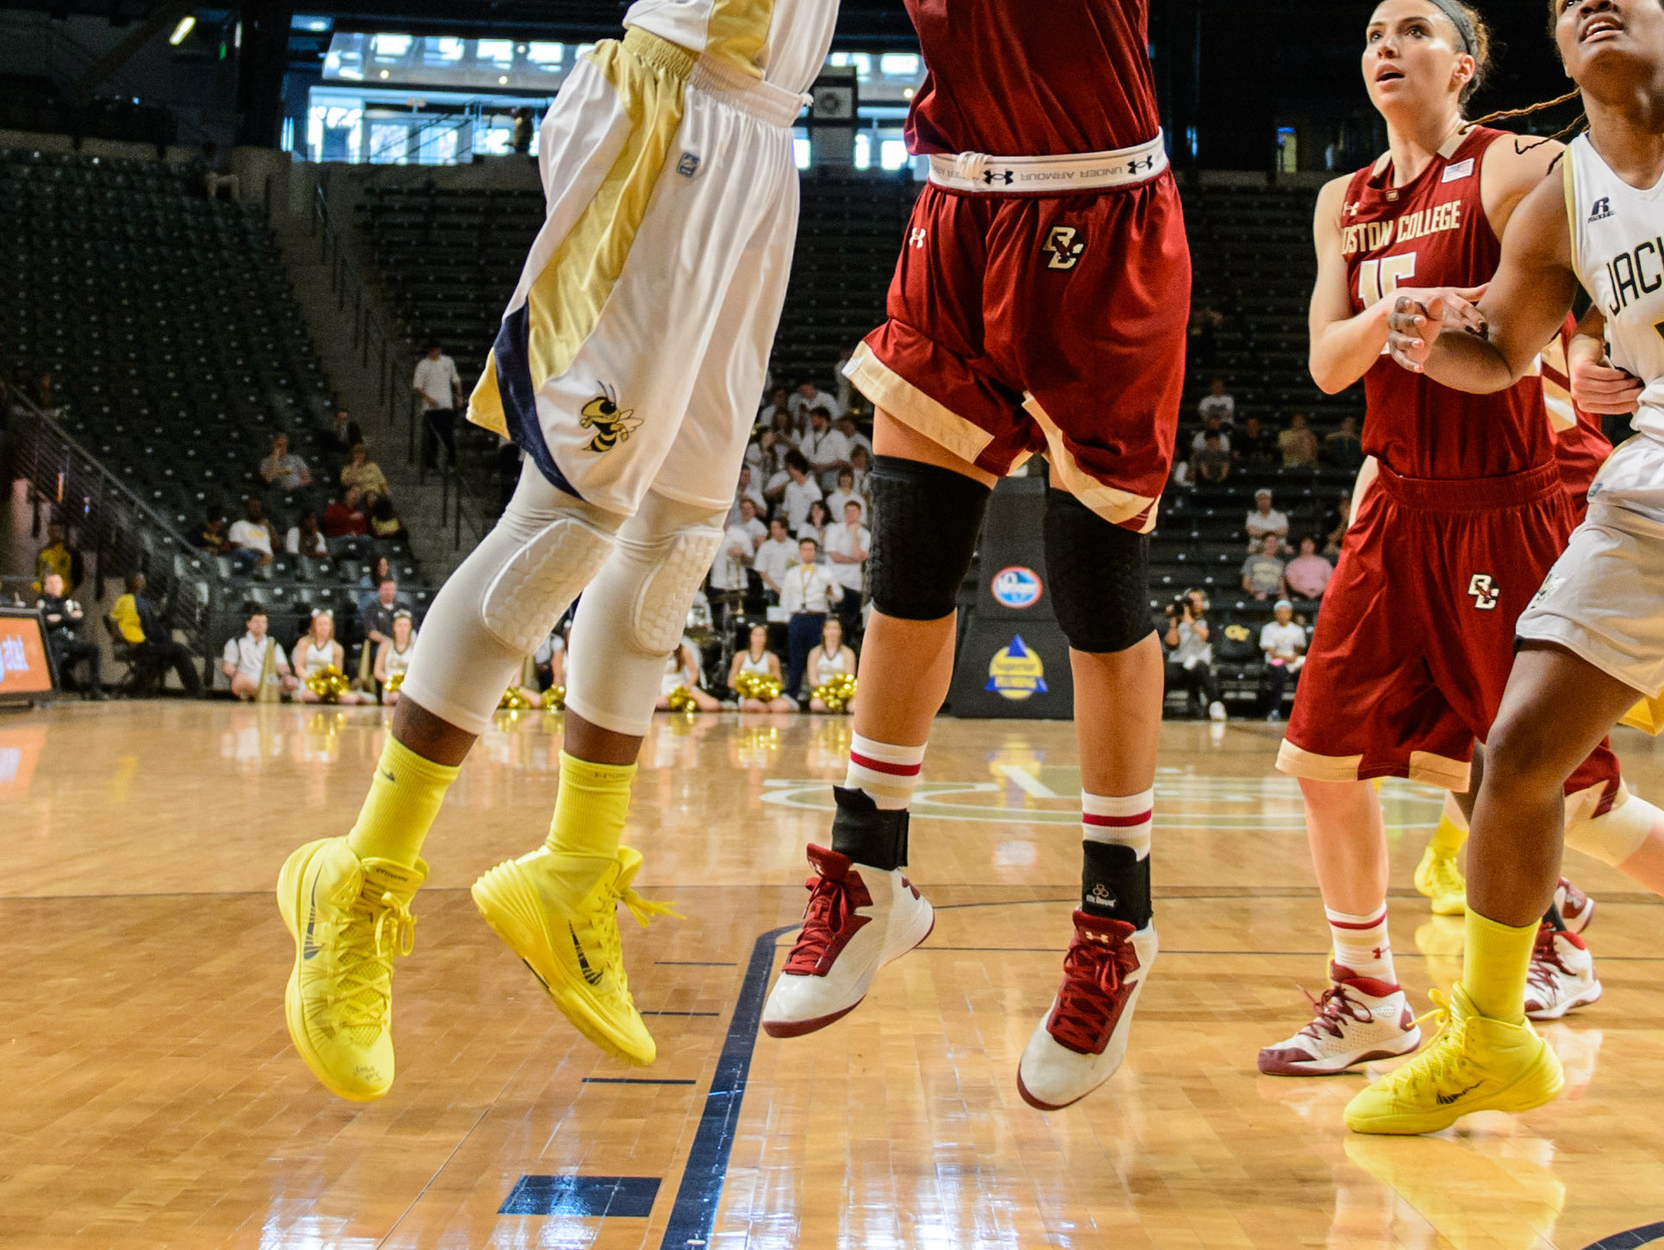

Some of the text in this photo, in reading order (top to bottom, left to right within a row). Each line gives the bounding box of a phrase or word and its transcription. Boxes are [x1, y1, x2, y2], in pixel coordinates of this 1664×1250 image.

[1020, 166, 1123, 182] UNDER ARMOUR
[1396, 200, 1461, 244] COLLEGE
[1606, 236, 1664, 317] JAC
